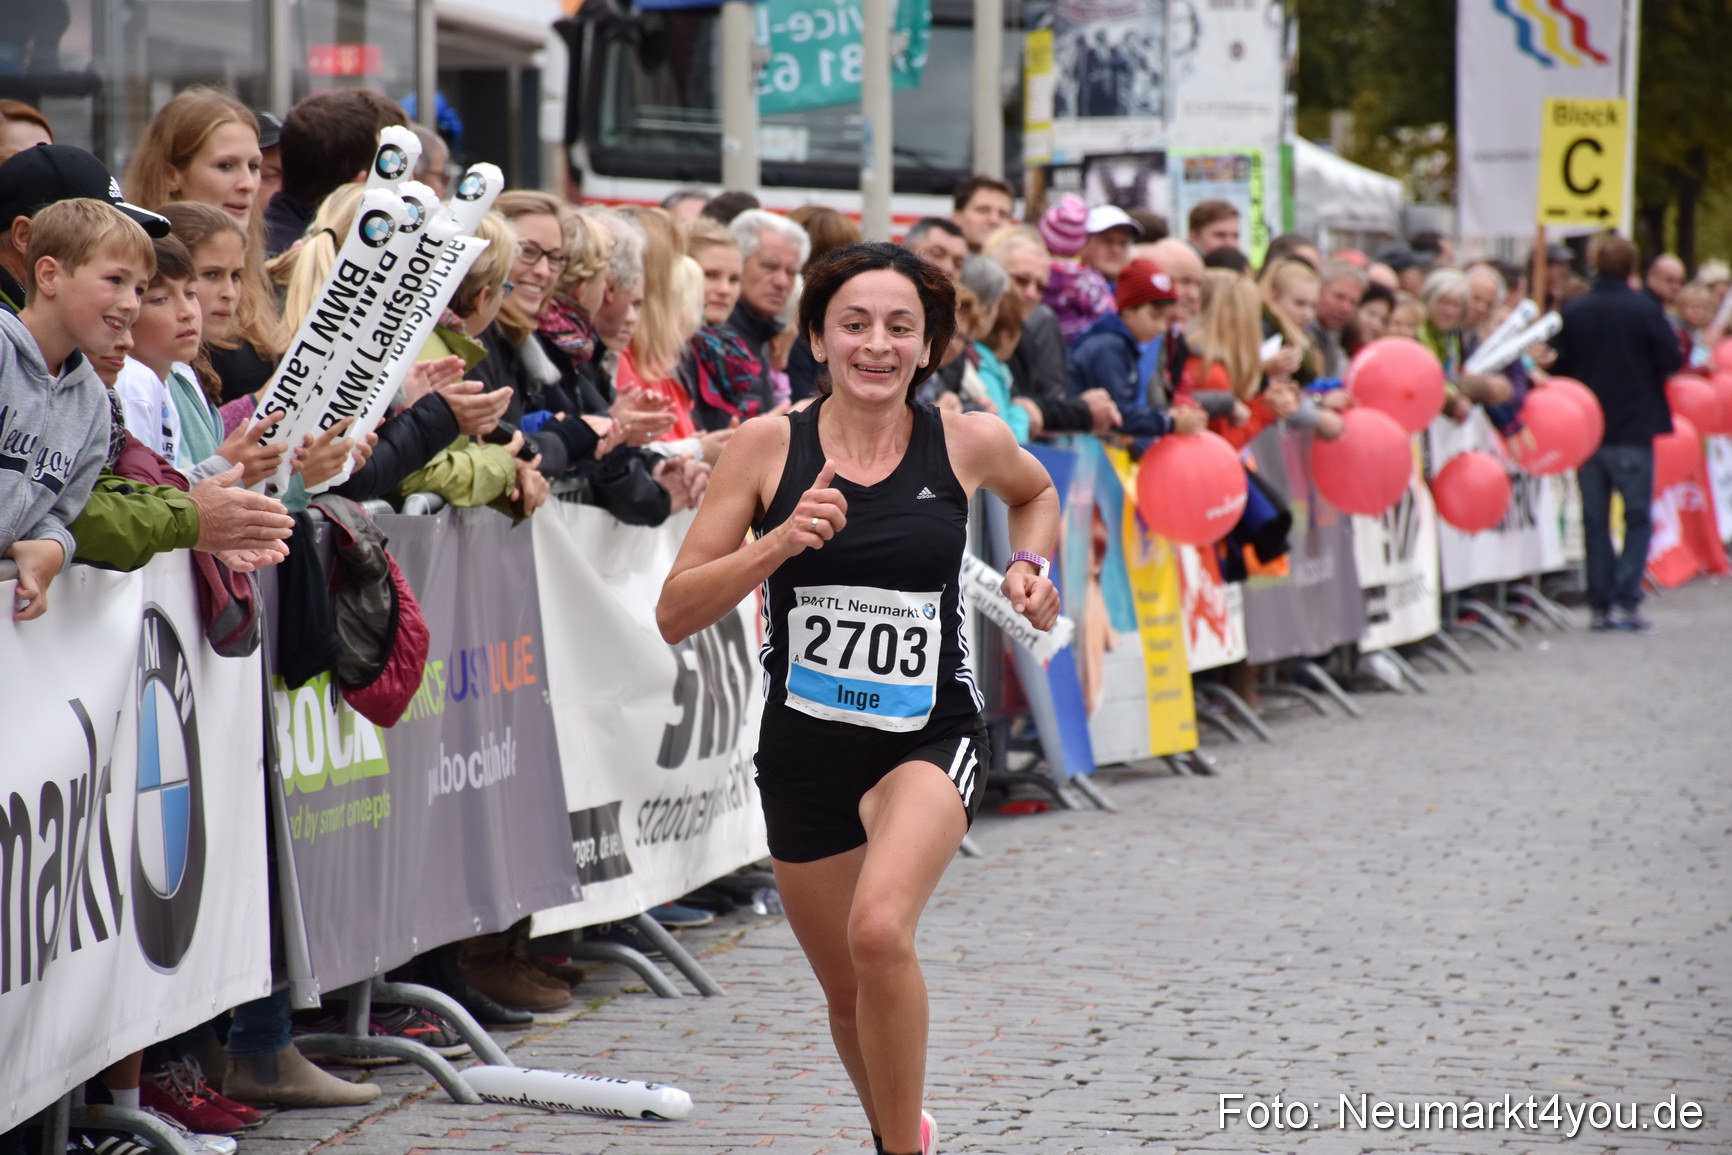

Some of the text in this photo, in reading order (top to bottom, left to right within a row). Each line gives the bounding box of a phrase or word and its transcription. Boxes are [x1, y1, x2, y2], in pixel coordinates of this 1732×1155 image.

[1553, 104, 1618, 127] Block
[1561, 137, 1604, 196] C
[309, 258, 370, 343] BMW
[319, 359, 374, 439] BMW
[356, 232, 444, 364] Laufsport
[801, 596, 920, 618] PARTL Neumarkt
[804, 615, 928, 678] 2703
[837, 684, 881, 711] Inge
[304, 804, 319, 845] by
